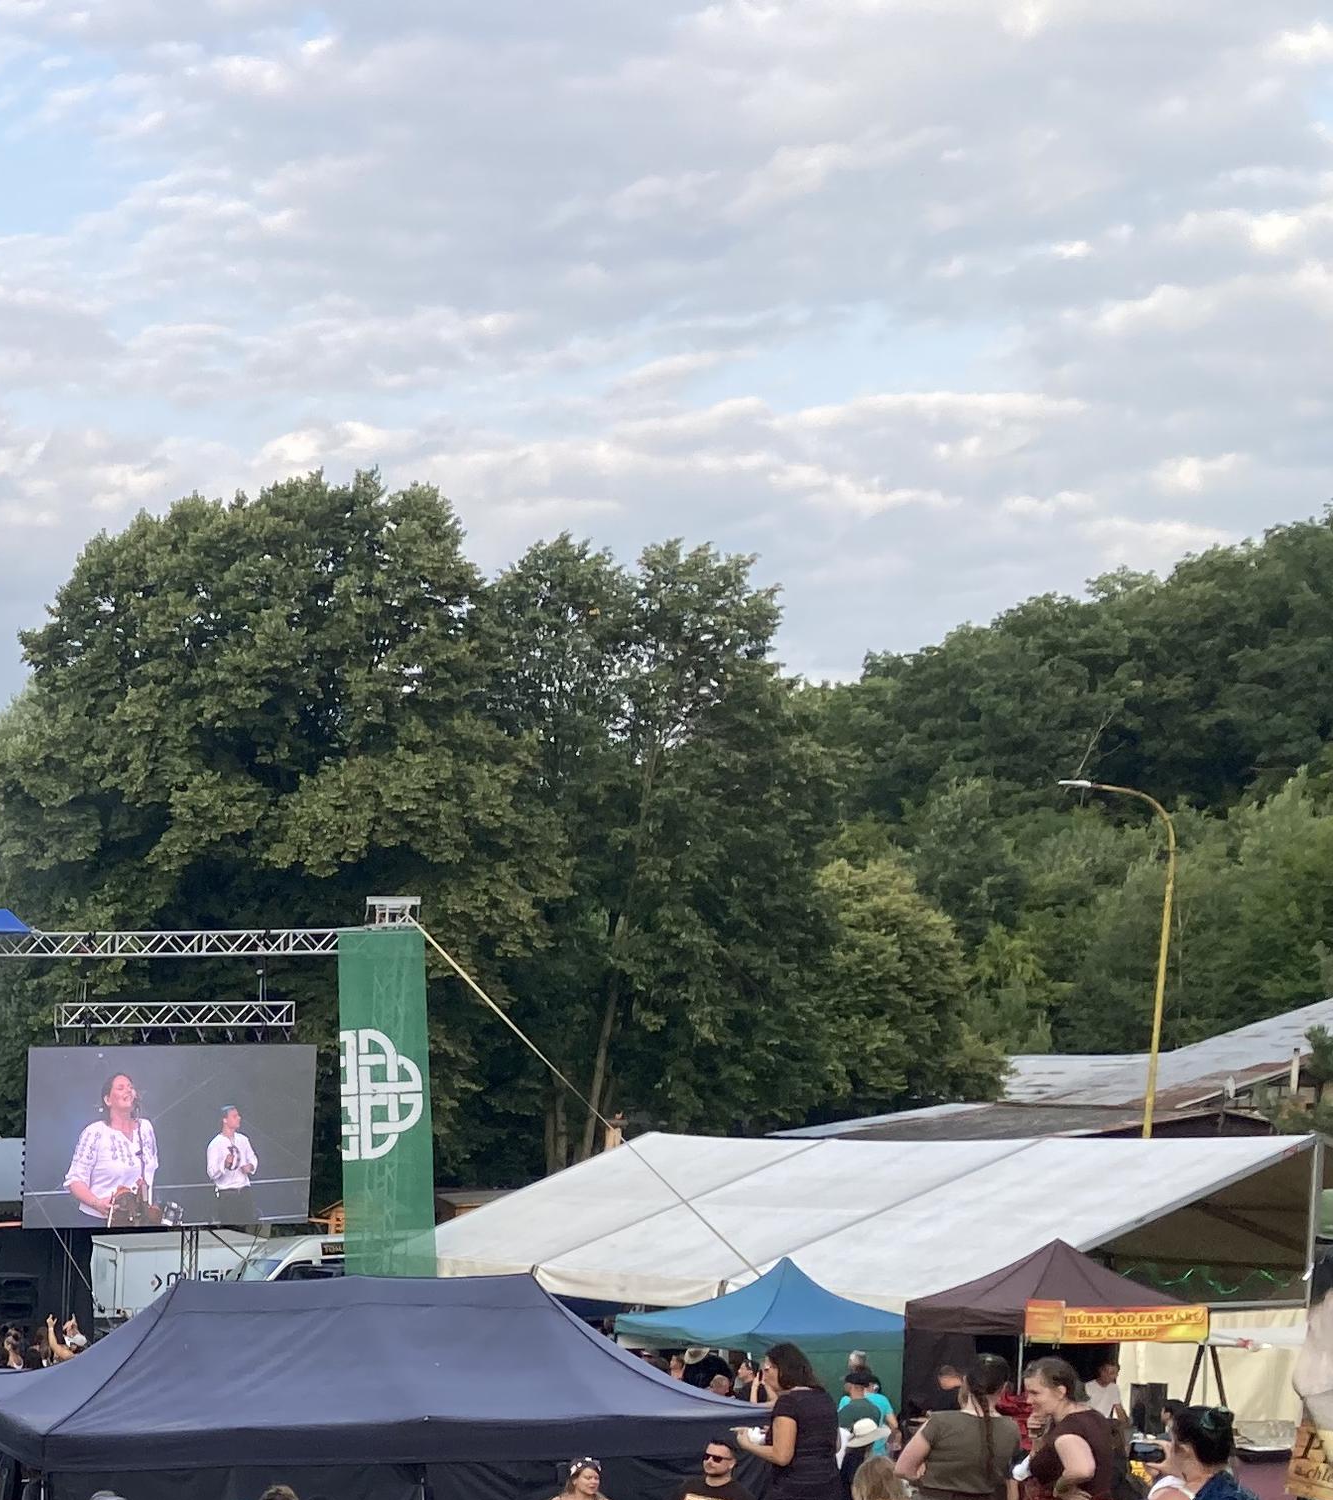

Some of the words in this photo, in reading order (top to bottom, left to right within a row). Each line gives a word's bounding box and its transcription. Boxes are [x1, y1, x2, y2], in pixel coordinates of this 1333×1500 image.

[1118, 1314, 1136, 1324] OD
[1078, 1328, 1103, 1338] BEZ
[1107, 1327, 1156, 1338] CHEMIE
